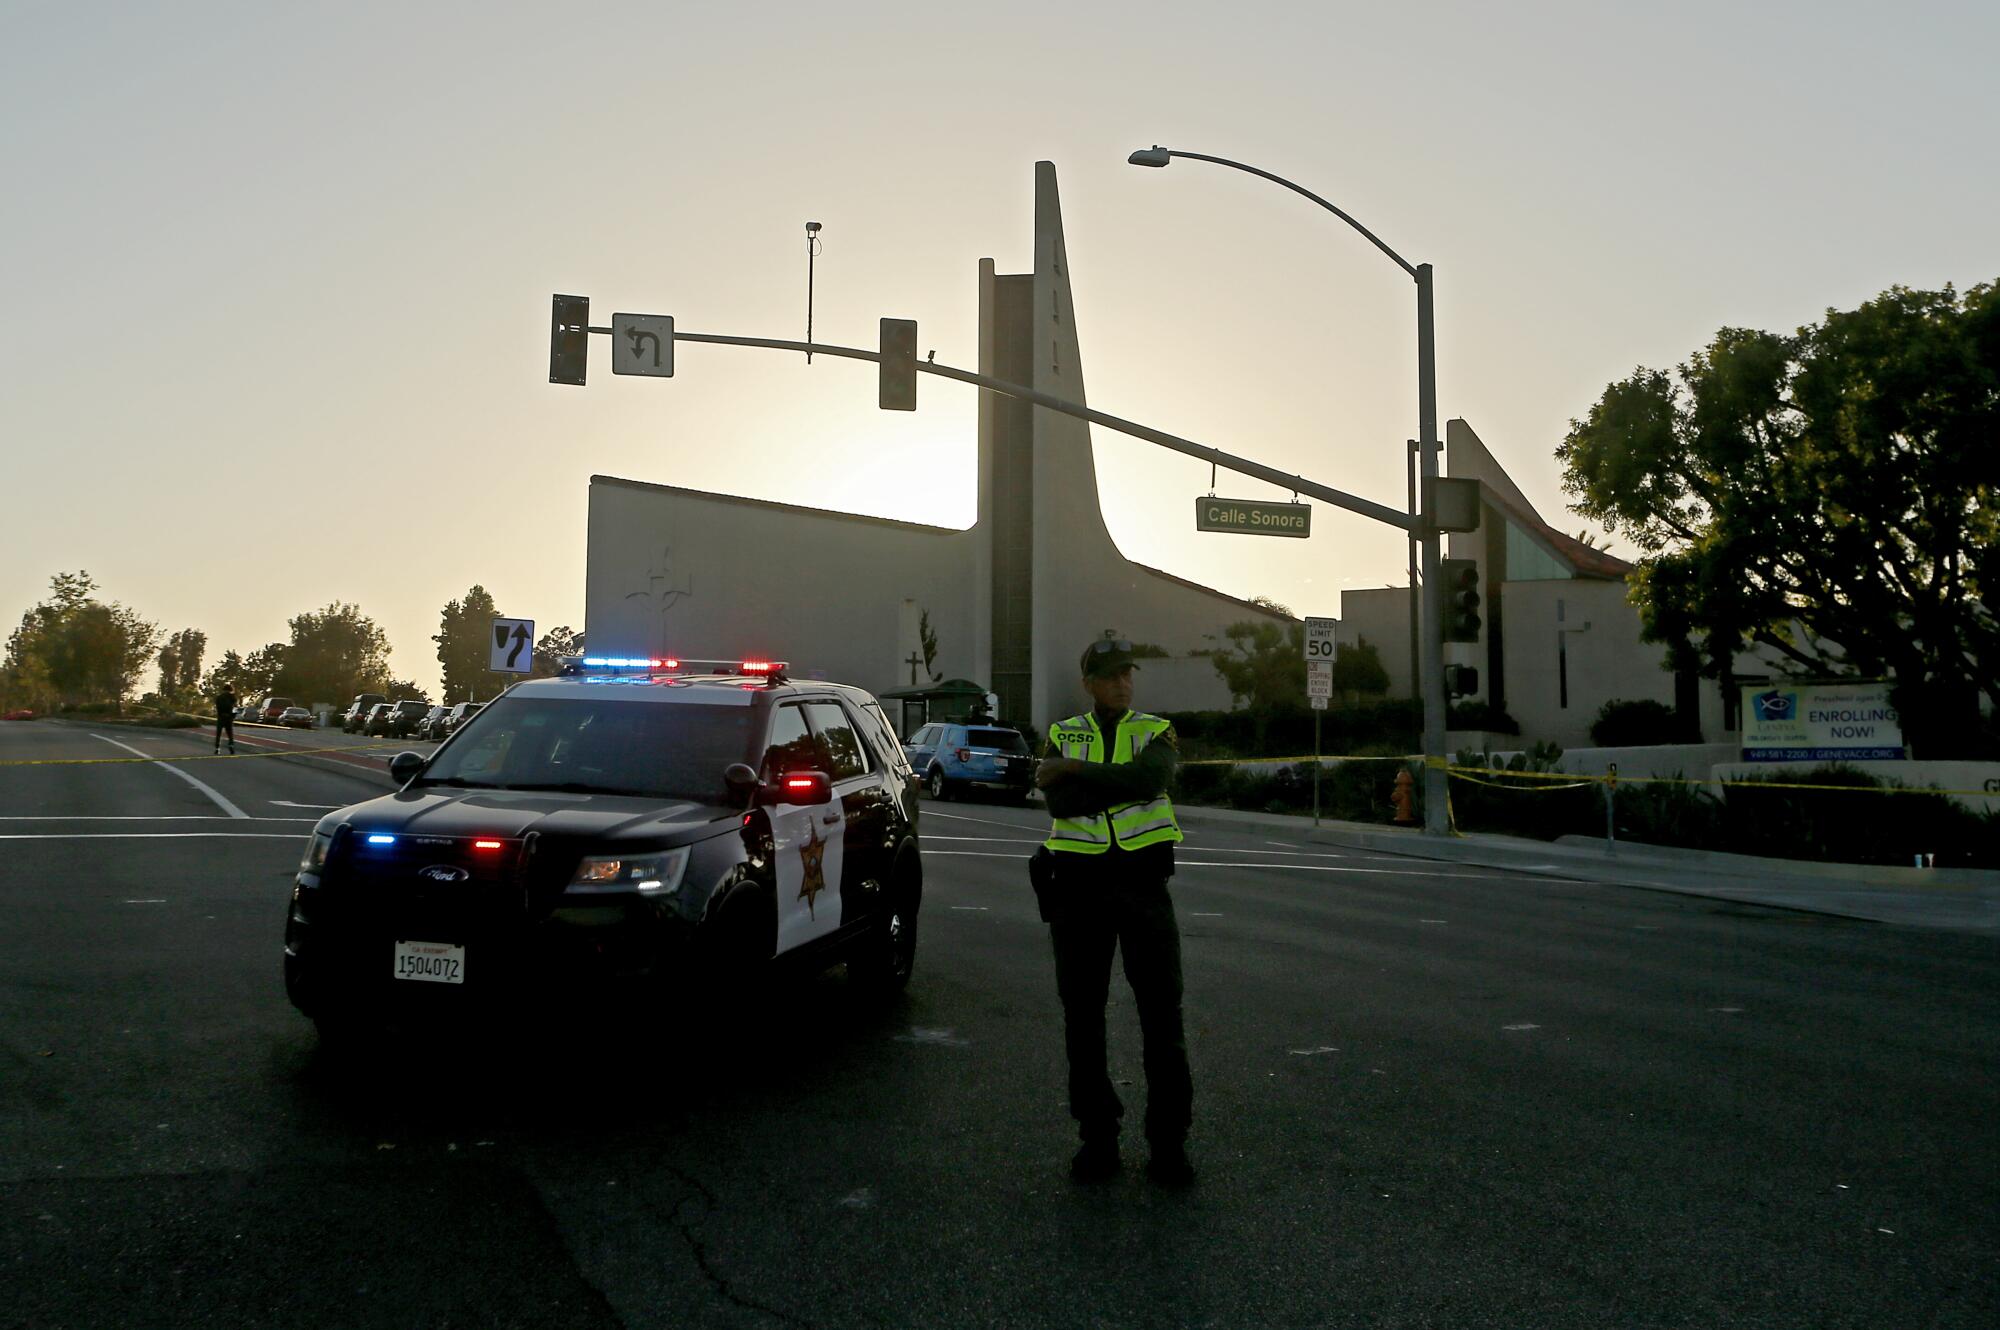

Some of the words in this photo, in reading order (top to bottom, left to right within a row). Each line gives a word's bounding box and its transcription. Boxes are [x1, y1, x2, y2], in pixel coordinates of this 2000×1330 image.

[1208, 507, 1246, 524] Calle
[1251, 510, 1304, 528] Sonora
[1308, 620, 1334, 629] SPEED
[1309, 641, 1332, 656] 50
[1809, 708, 1897, 722] ENROLLING
[1057, 733, 1094, 743] OCSD
[1831, 726, 1875, 738] NOW!
[426, 869, 457, 881] Ford
[399, 956, 459, 978] 1504072
